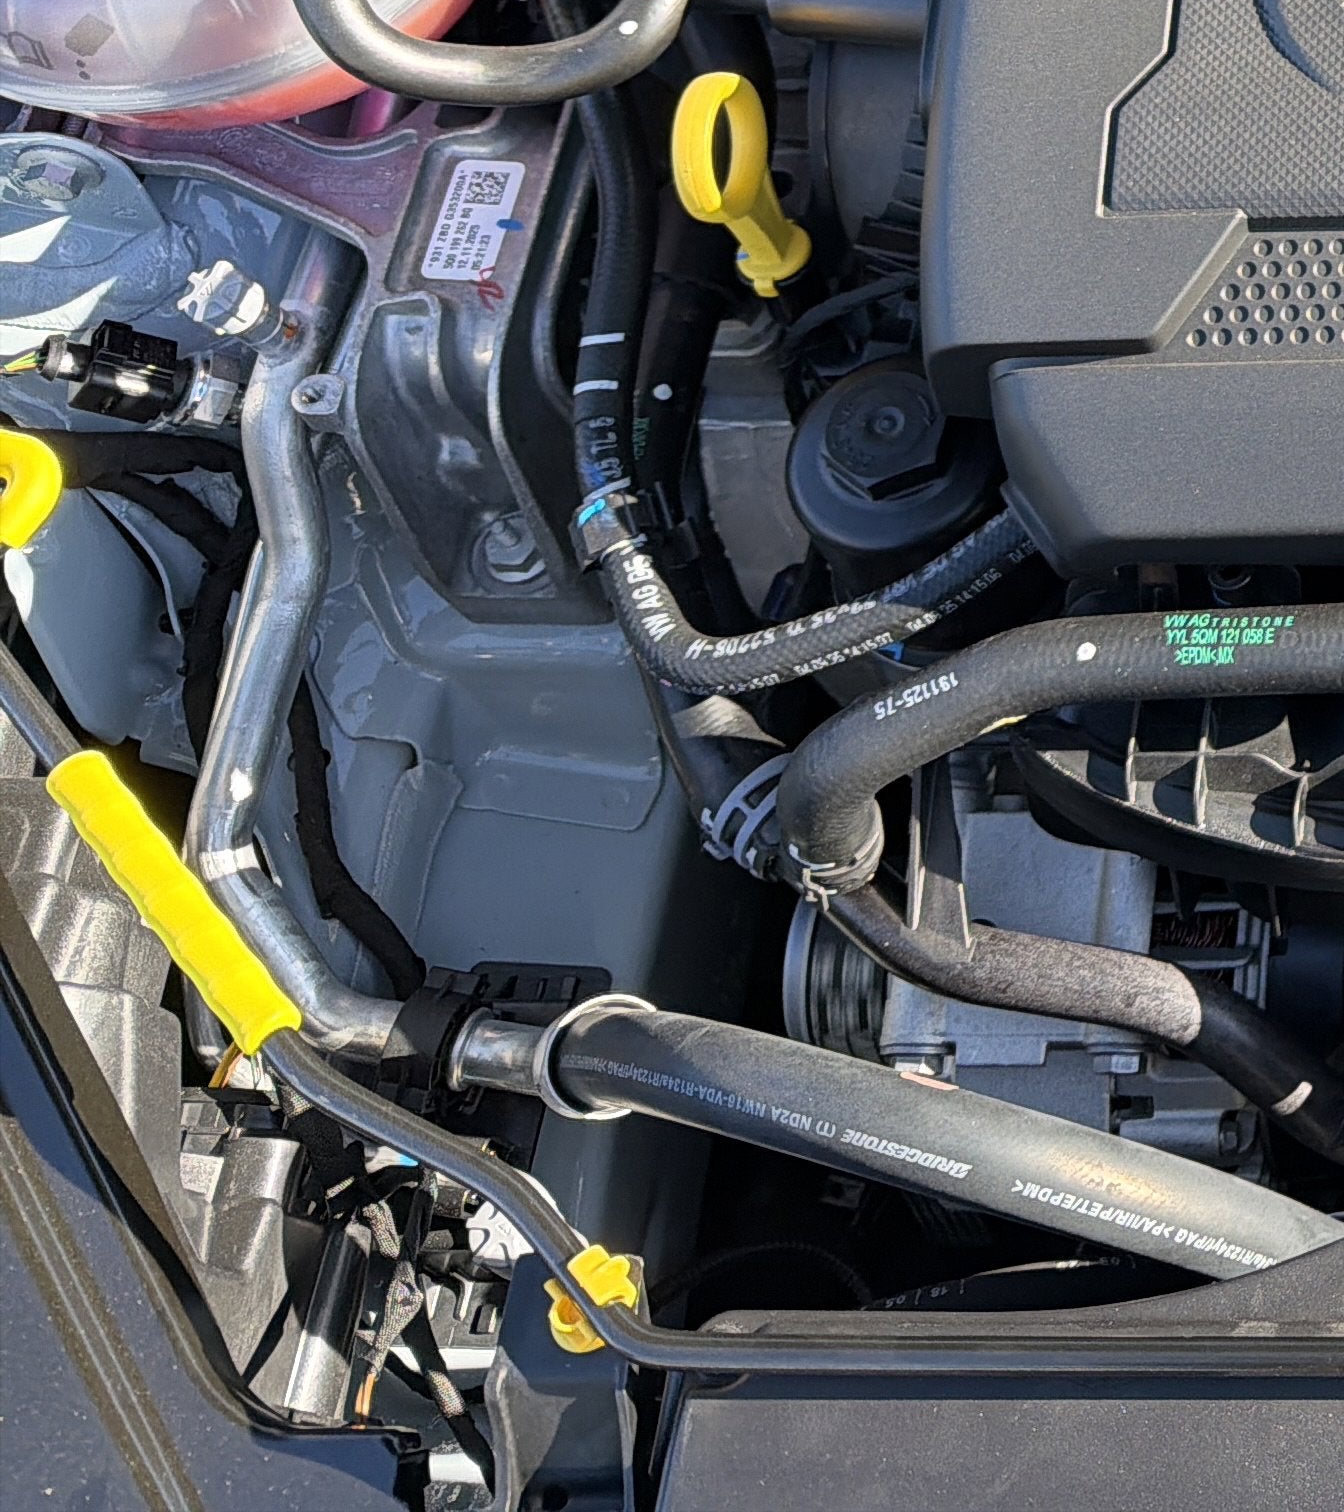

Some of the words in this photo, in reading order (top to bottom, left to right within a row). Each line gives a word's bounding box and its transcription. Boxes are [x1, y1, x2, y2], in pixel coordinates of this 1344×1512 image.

[632, 586, 663, 612] AG
[644, 615, 676, 641] VW
[1163, 614, 1189, 627] VW
[1187, 613, 1211, 627] AG
[1212, 616, 1294, 626] TRISTONE
[1166, 629, 1188, 645] YYL
[1190, 629, 1217, 644] 5QM
[1220, 628, 1239, 644] 121
[1242, 628, 1263, 644] 058
[1264, 628, 1275, 643] E
[873, 672, 958, 720] 191125-75
[767, 1105, 813, 1131] ND2A
[813, 1118, 837, 1139] (T)
[840, 1127, 972, 1180] BRIDGESTONE
[1011, 1177, 1175, 1238] >PA/IIR/PET/EPDM<
